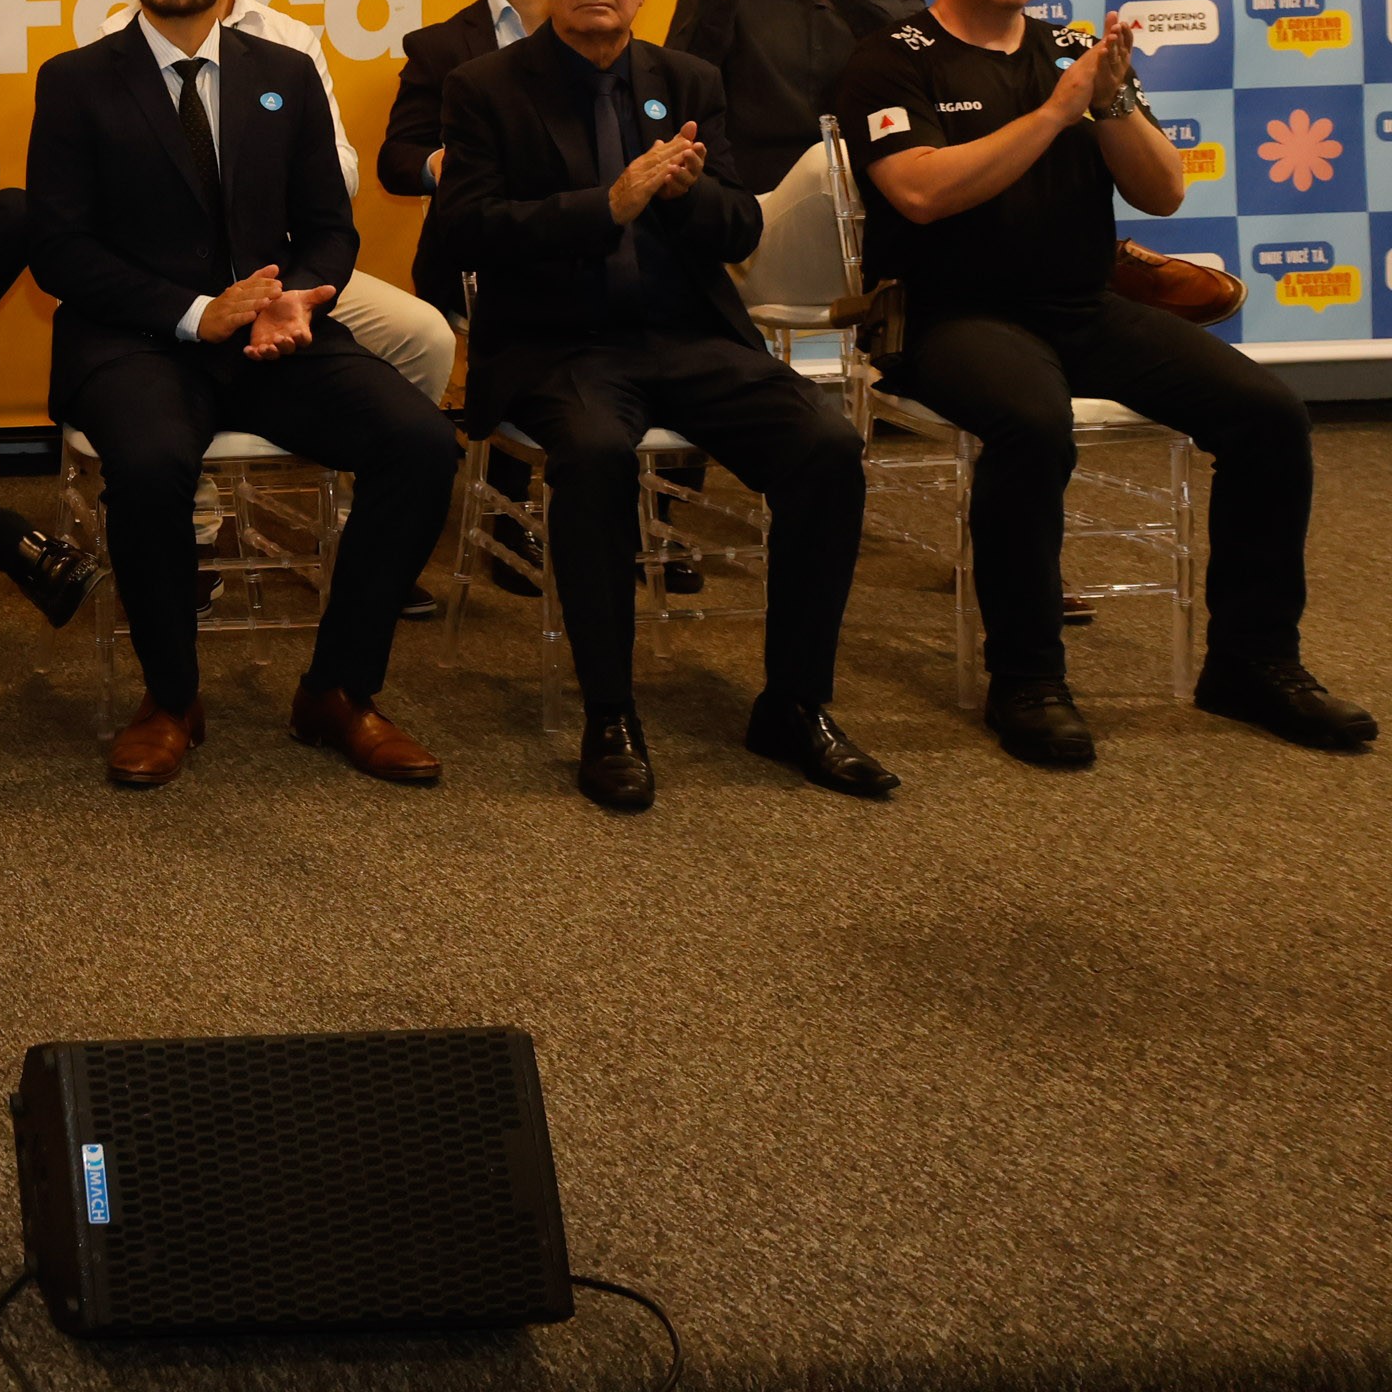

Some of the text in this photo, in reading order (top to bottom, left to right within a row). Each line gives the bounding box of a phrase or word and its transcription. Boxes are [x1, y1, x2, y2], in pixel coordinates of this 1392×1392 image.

[1148, 12, 1206, 22] GOVERNO
[1148, 22, 1207, 33] DE MINAS
[89, 1171, 106, 1221] MACH
